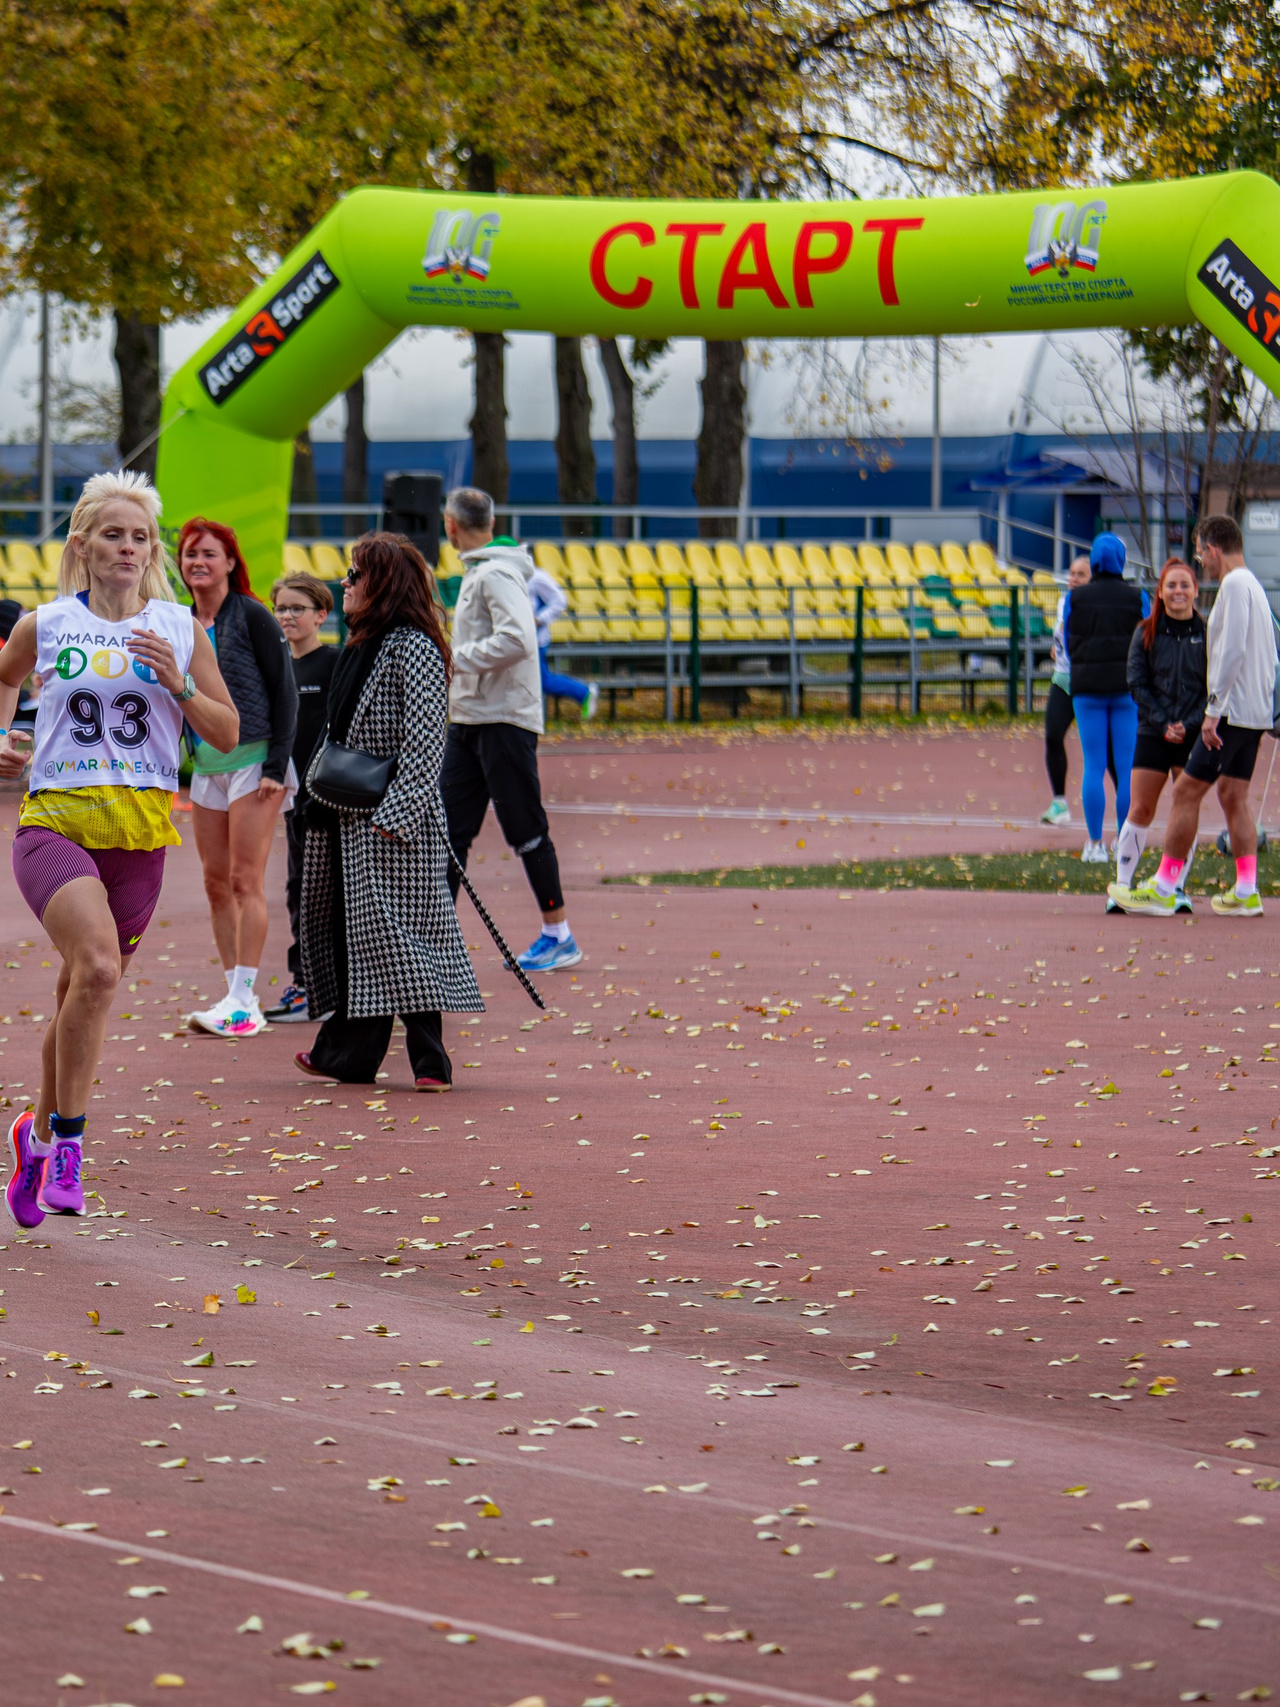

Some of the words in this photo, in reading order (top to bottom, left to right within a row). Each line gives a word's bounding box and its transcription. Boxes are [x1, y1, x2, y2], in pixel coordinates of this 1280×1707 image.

[589, 217, 925, 310] СТАРТ
[1010, 281, 1086, 294] МИНИСТЕРСТВО
[1088, 277, 1127, 291] СПОРТА
[1206, 253, 1255, 310] Arta
[1007, 293, 1071, 306] РОССИЙСКОЙ
[1073, 288, 1135, 302] ФЕДЕРАЦИИ
[206, 342, 256, 396] Arta
[271, 262, 334, 328] Sport
[66, 687, 152, 750] 93
